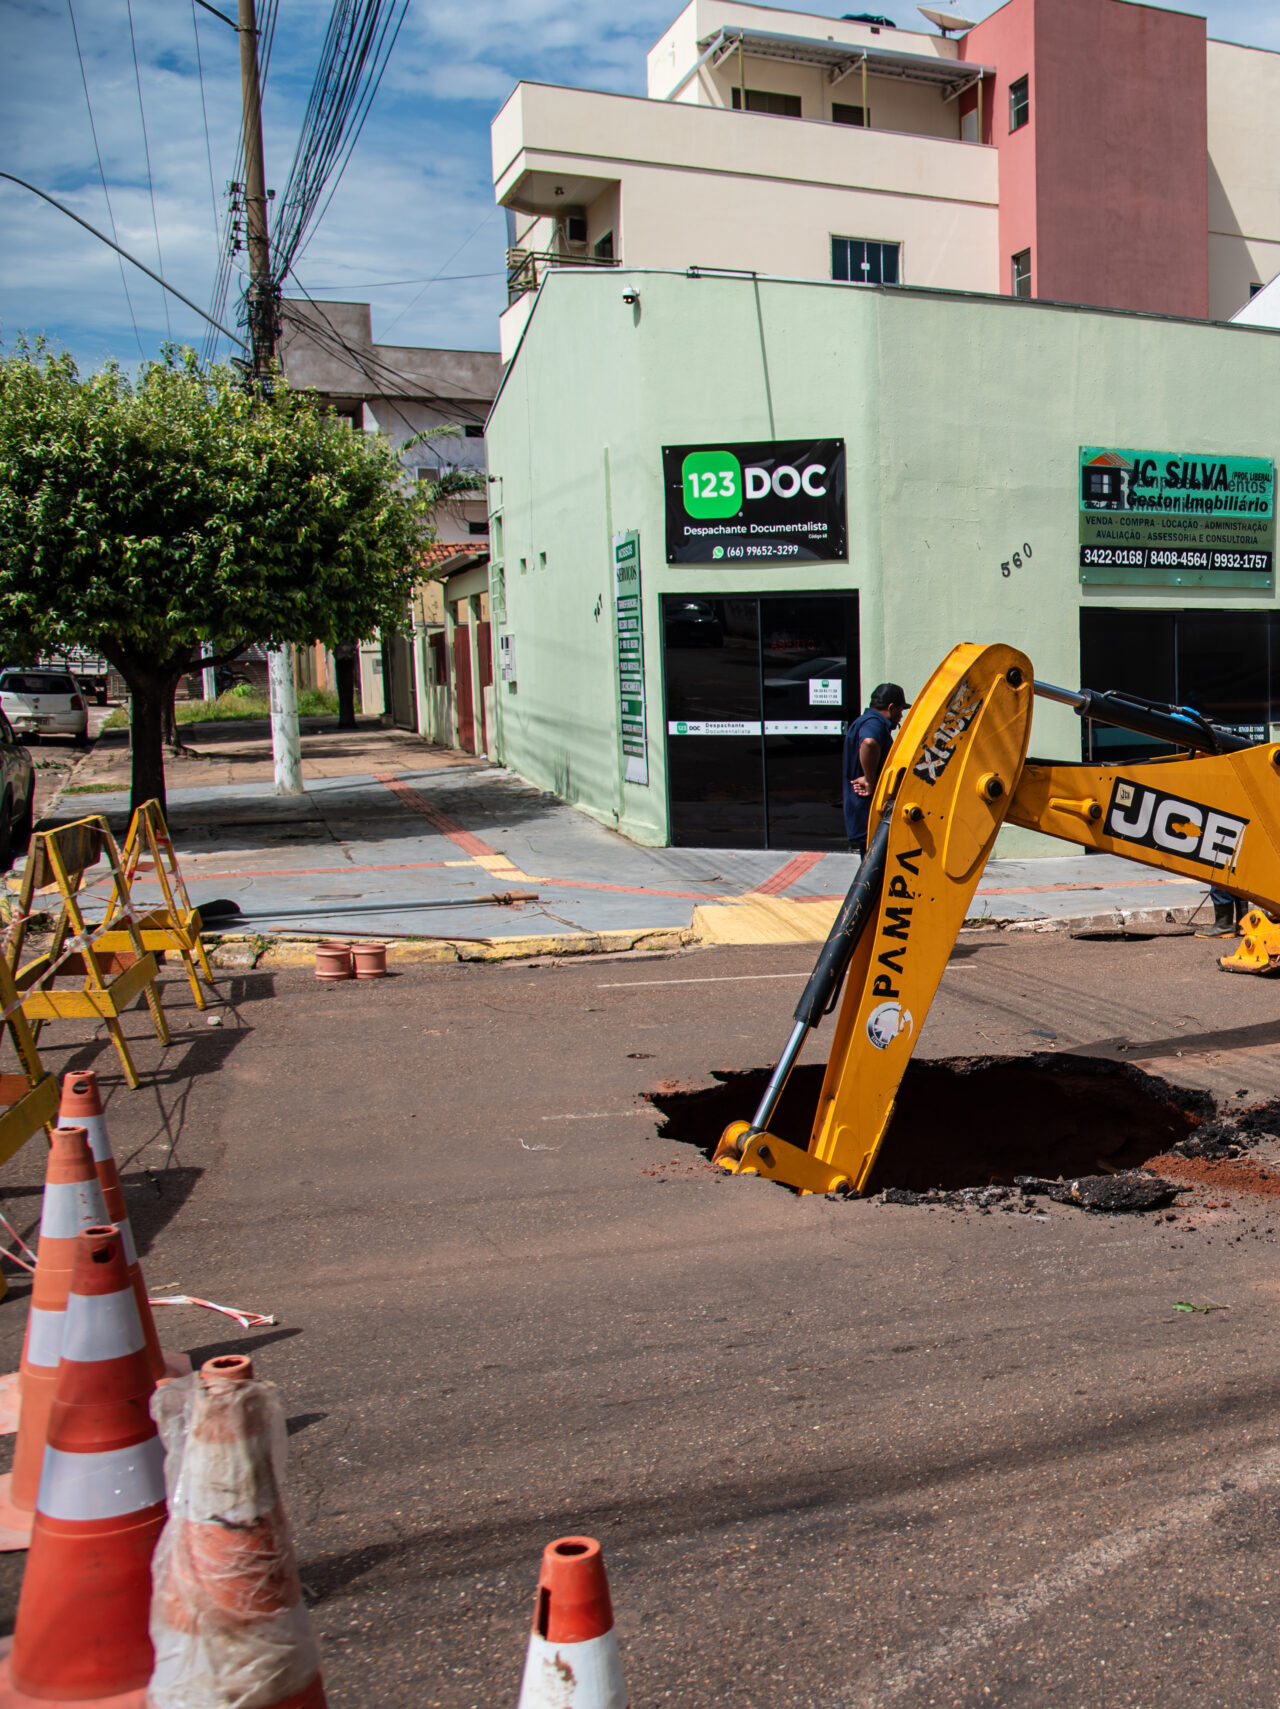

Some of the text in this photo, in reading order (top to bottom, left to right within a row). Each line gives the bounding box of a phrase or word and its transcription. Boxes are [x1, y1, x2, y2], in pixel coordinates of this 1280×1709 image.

[688, 464, 827, 499] 123 DOC
[1128, 458, 1157, 487] JC
[1165, 460, 1229, 492] SILVA
[1127, 489, 1180, 509] Gestor
[1185, 494, 1269, 513] Imobiliário
[683, 522, 828, 537] Despachante Documentalista
[1085, 515, 1113, 525] VENDA
[1120, 517, 1155, 527] COMPRA
[1162, 518, 1199, 531] LOCAÇÃO
[1205, 521, 1268, 533] ADMINISTRAÇÃO
[1096, 528, 1141, 541] AVALIAÇÃO
[1147, 531, 1197, 543] ASSESSORIA
[1199, 534, 1204, 543] E
[1206, 534, 1258, 545] CONSULTORIA
[727, 545, 799, 557] (66) 99652-3299
[1001, 542, 1033, 578] 560
[1084, 549, 1143, 565] 3422-0168
[1150, 550, 1207, 567] 8408-4564
[1214, 553, 1268, 569] 9932-1757
[1110, 790, 1247, 868] JCB
[872, 847, 923, 998] PAMPA
